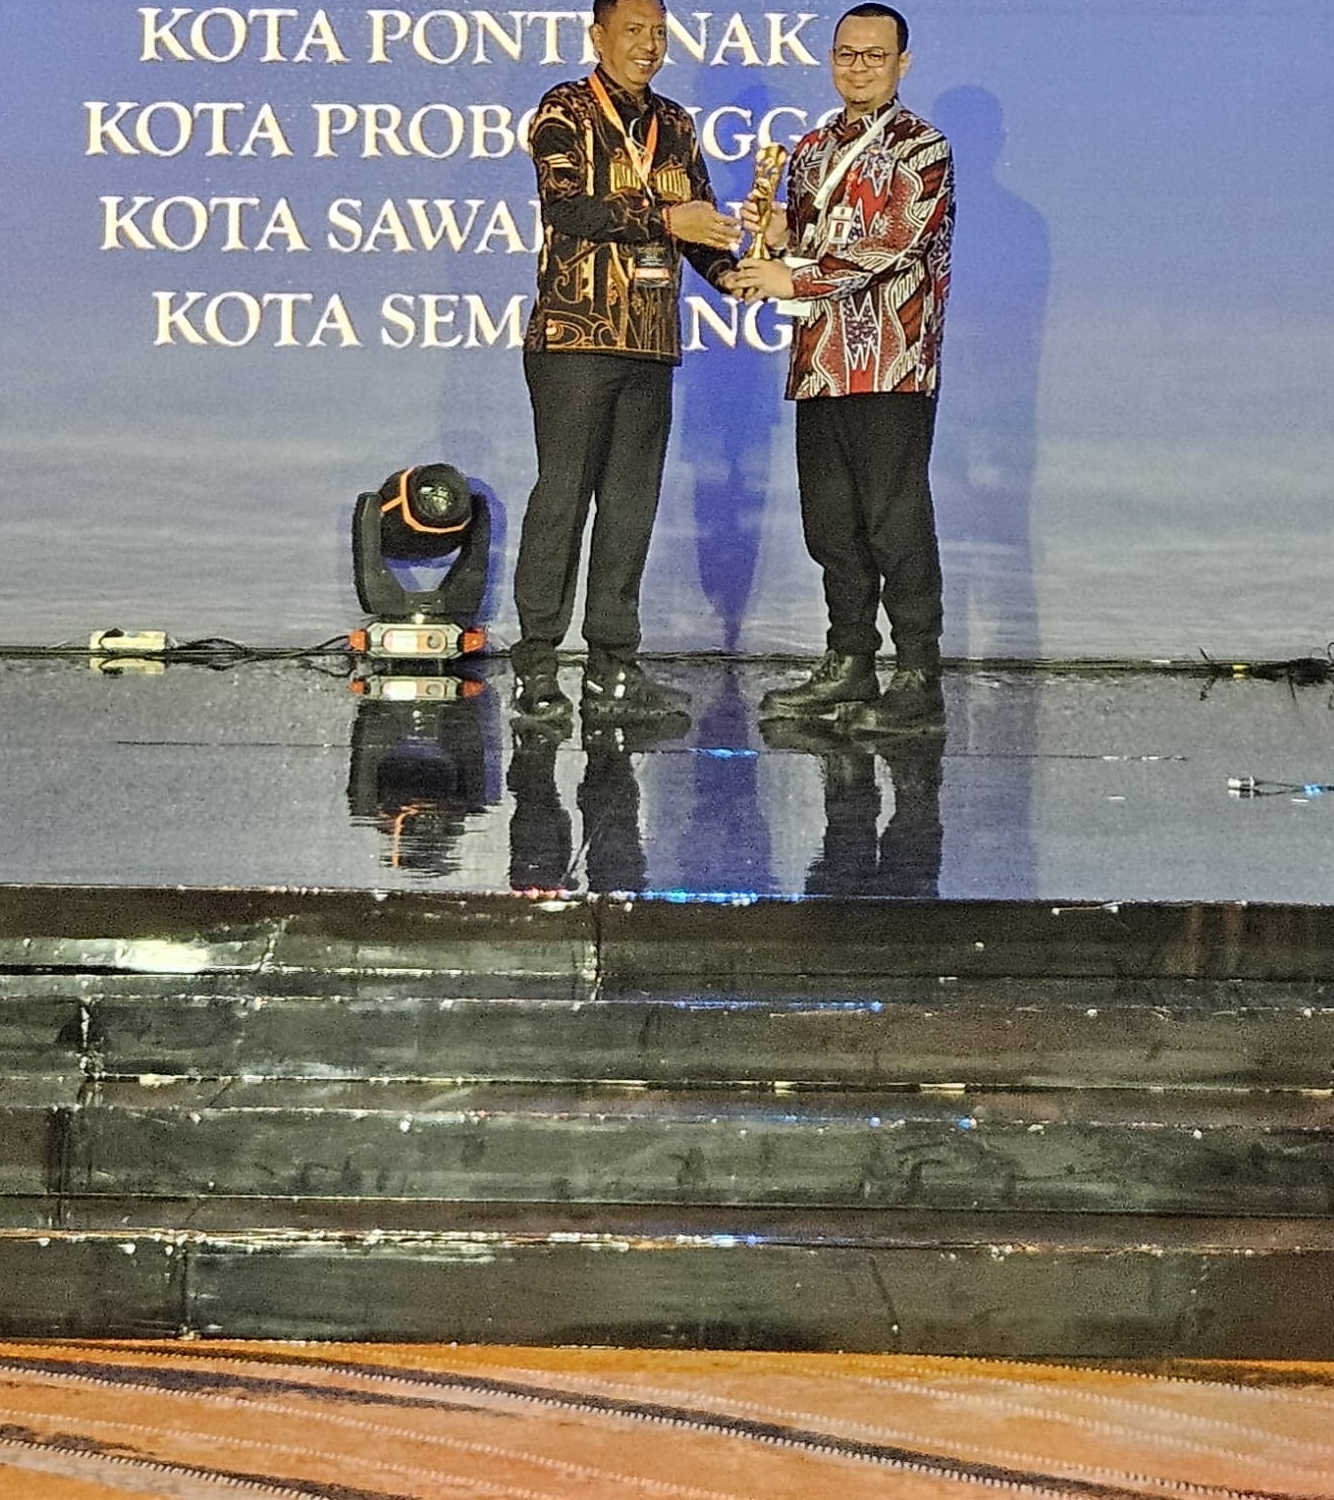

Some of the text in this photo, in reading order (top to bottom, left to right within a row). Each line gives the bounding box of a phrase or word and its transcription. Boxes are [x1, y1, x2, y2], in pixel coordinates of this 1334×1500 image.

[138, 7, 821, 67] KOTA PONTINAK
[83, 101, 292, 158] KOTA
[99, 195, 308, 253] KOTA
[152, 291, 793, 351] KOTA SEMNG
